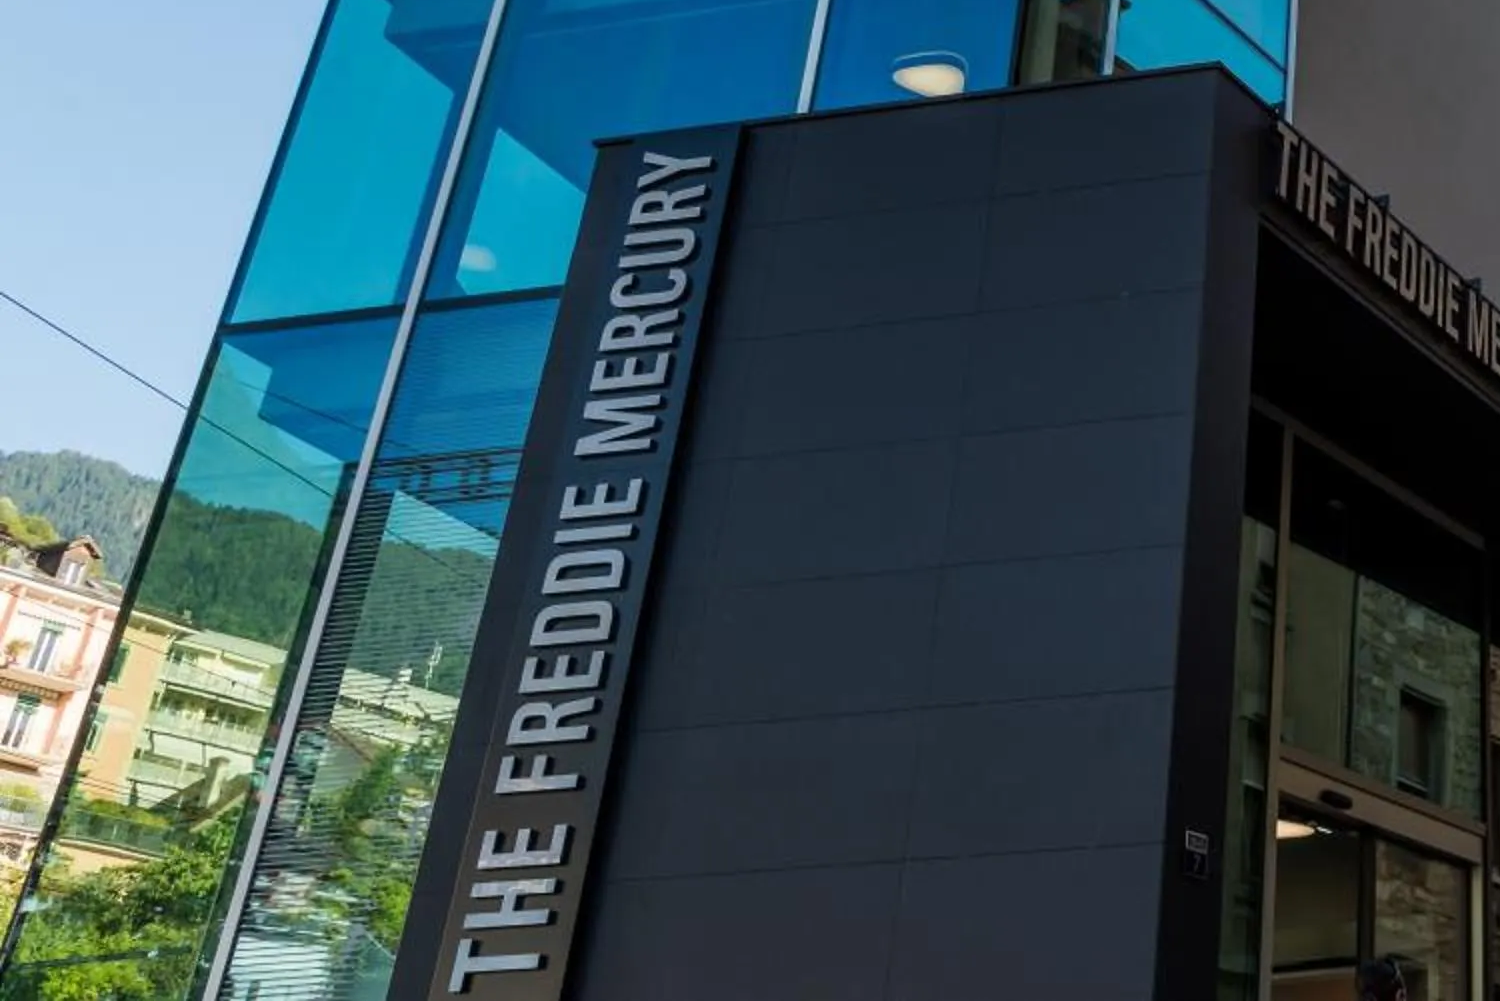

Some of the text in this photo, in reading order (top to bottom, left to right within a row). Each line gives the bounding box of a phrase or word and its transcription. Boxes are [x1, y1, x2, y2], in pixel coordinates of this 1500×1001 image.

[1276, 125, 1337, 239] THE
[1346, 185, 1460, 344] FREDDIE
[449, 149, 714, 993] THE FREDDIE MERCURY
